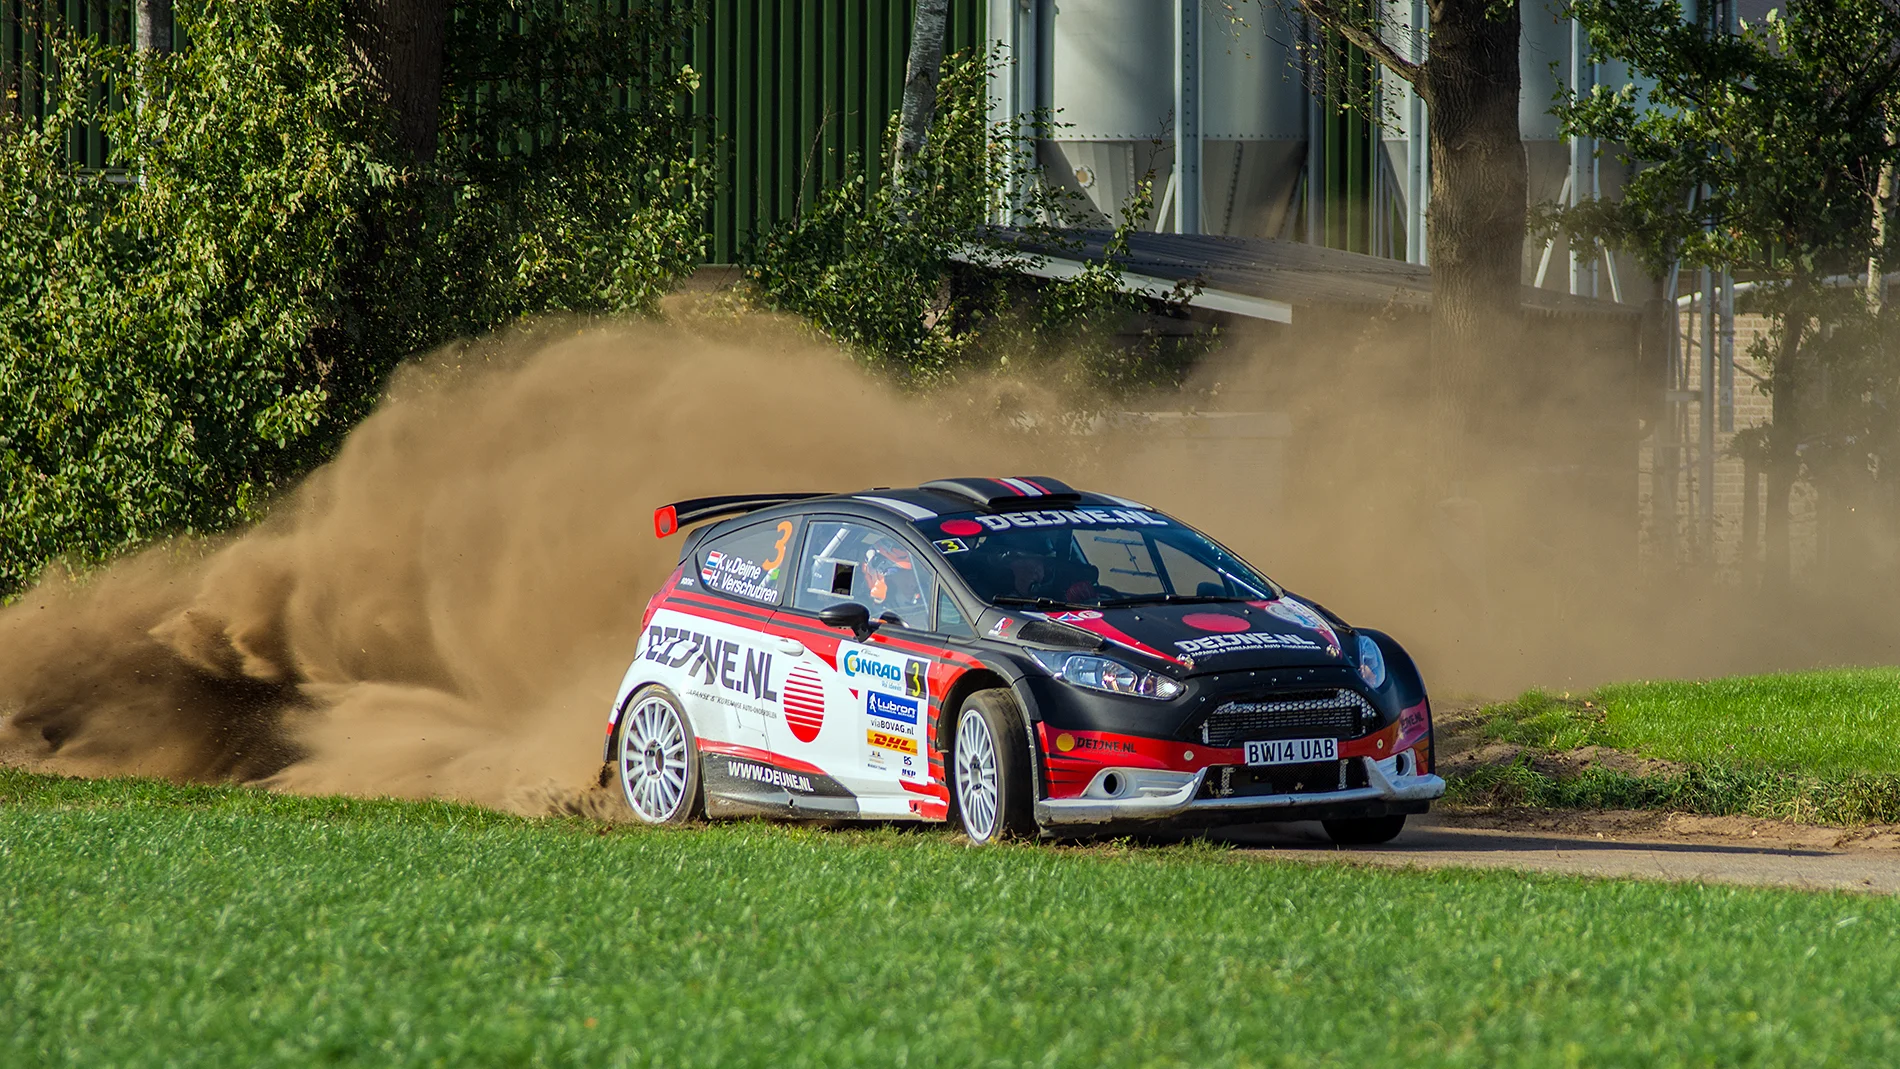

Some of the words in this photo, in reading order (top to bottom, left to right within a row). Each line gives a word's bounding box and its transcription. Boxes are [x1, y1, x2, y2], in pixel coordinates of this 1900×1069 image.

[975, 509, 1168, 531] DEIJNE.NL
[763, 521, 792, 571] 3
[942, 540, 959, 551] 3
[708, 570, 720, 587] H.
[1174, 632, 1315, 652] DEIJNE.NL
[645, 626, 777, 702] DEIJNE.NL
[844, 650, 901, 681] CONRAD
[911, 662, 921, 696] 3
[878, 699, 916, 716] Lubron
[870, 718, 915, 735] viaBOVAG.nl
[873, 733, 911, 752] DHL
[1077, 737, 1136, 753] DEIJNE.NL
[1248, 742, 1295, 763] BW14
[1301, 739, 1335, 760] UAB
